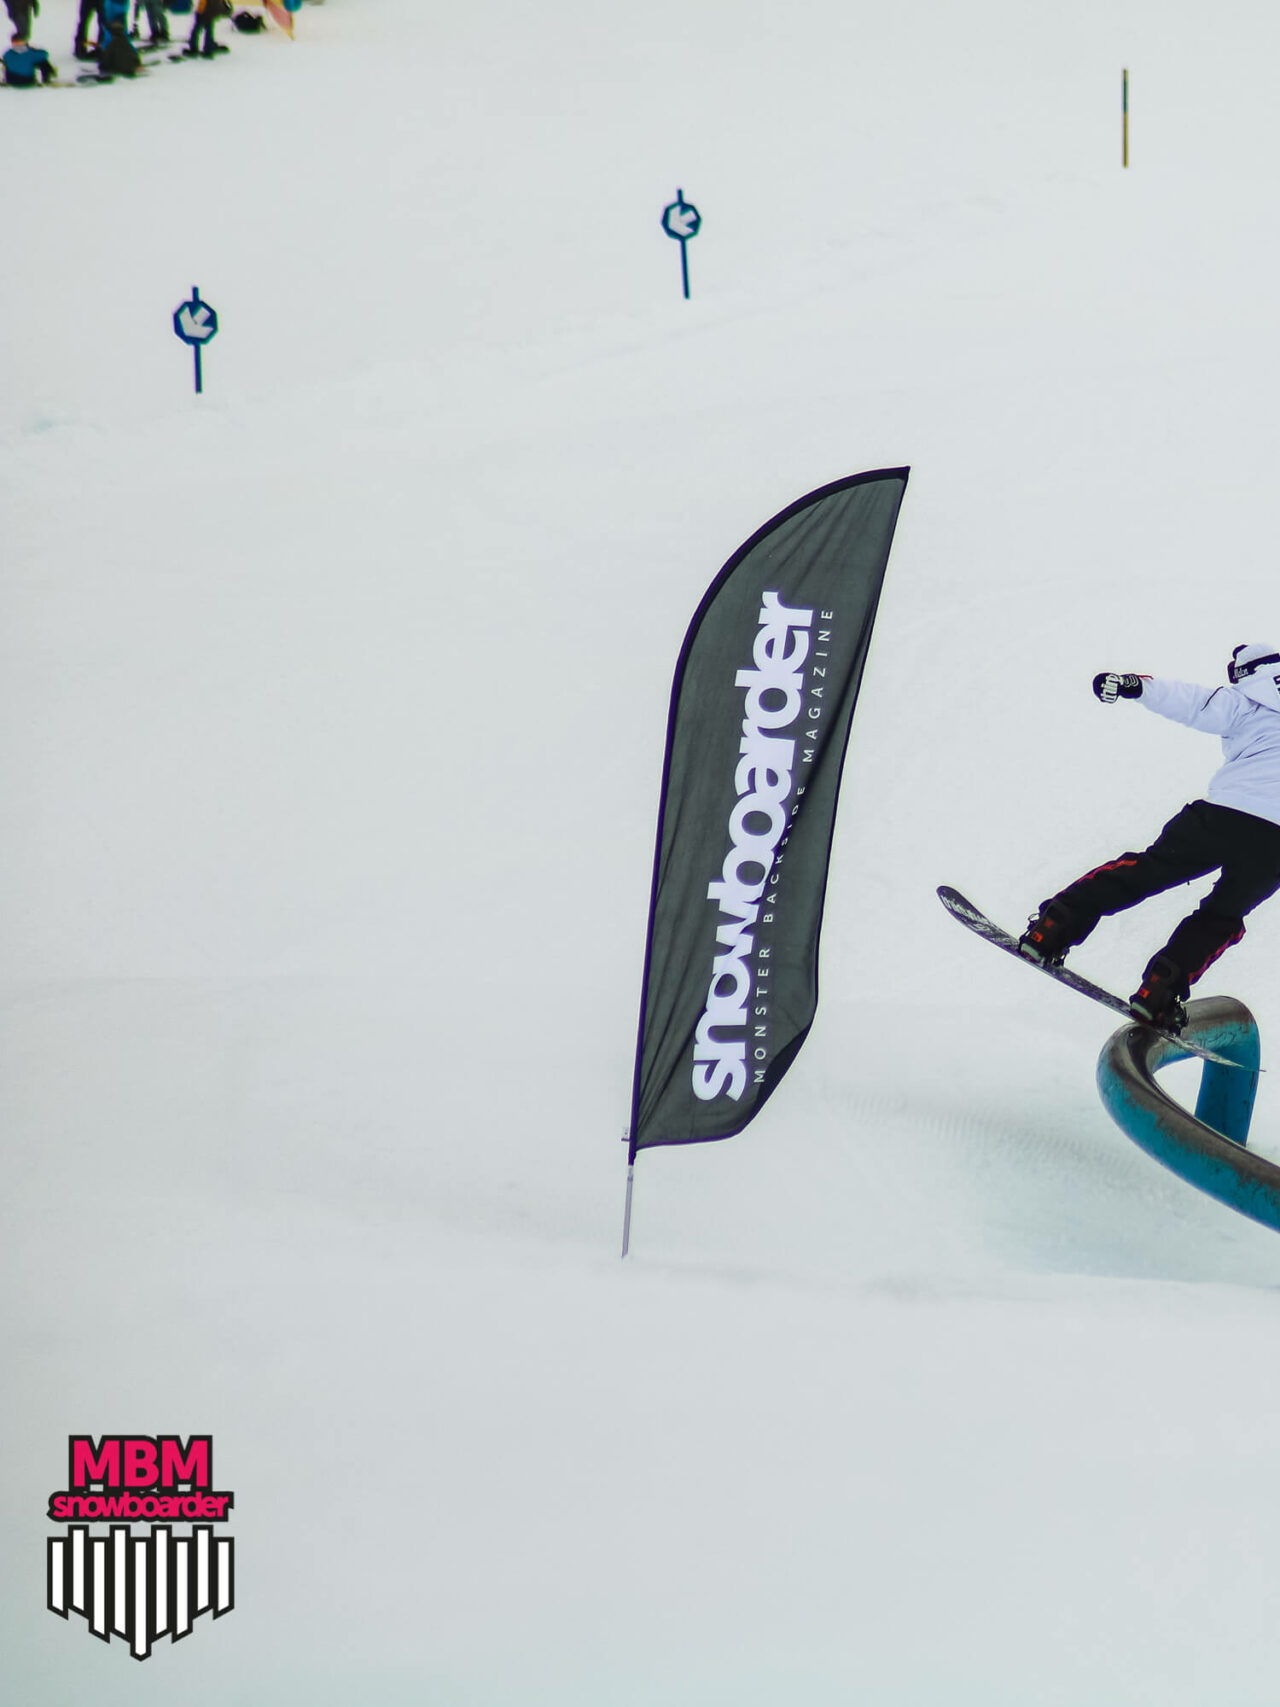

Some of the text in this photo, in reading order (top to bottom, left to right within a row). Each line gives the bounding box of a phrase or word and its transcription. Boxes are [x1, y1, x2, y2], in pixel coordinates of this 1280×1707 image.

[693, 591, 813, 1101] snowboarder
[753, 610, 833, 1083] MONSTER BACKSIDE MAGAZINE
